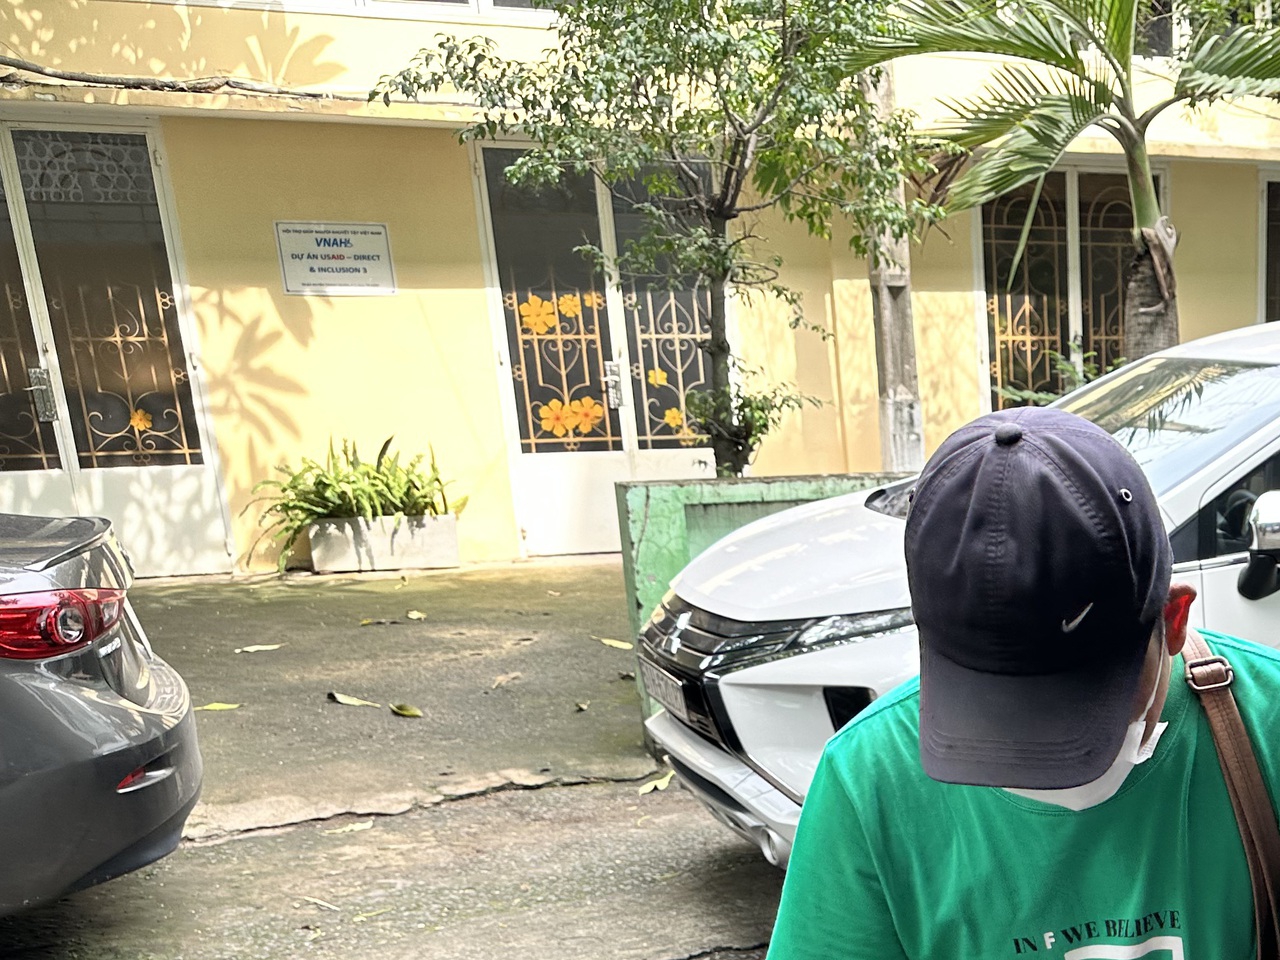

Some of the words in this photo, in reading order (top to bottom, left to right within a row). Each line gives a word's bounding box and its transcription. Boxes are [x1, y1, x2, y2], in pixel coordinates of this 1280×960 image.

[315, 238, 347, 248] VNAH
[291, 253, 304, 261] DỰ
[306, 252, 318, 260] ÁN
[1012, 936, 1038, 954] IN
[1043, 931, 1056, 949] F
[1060, 921, 1099, 945] WE
[1104, 910, 1181, 938] BELIEVE
